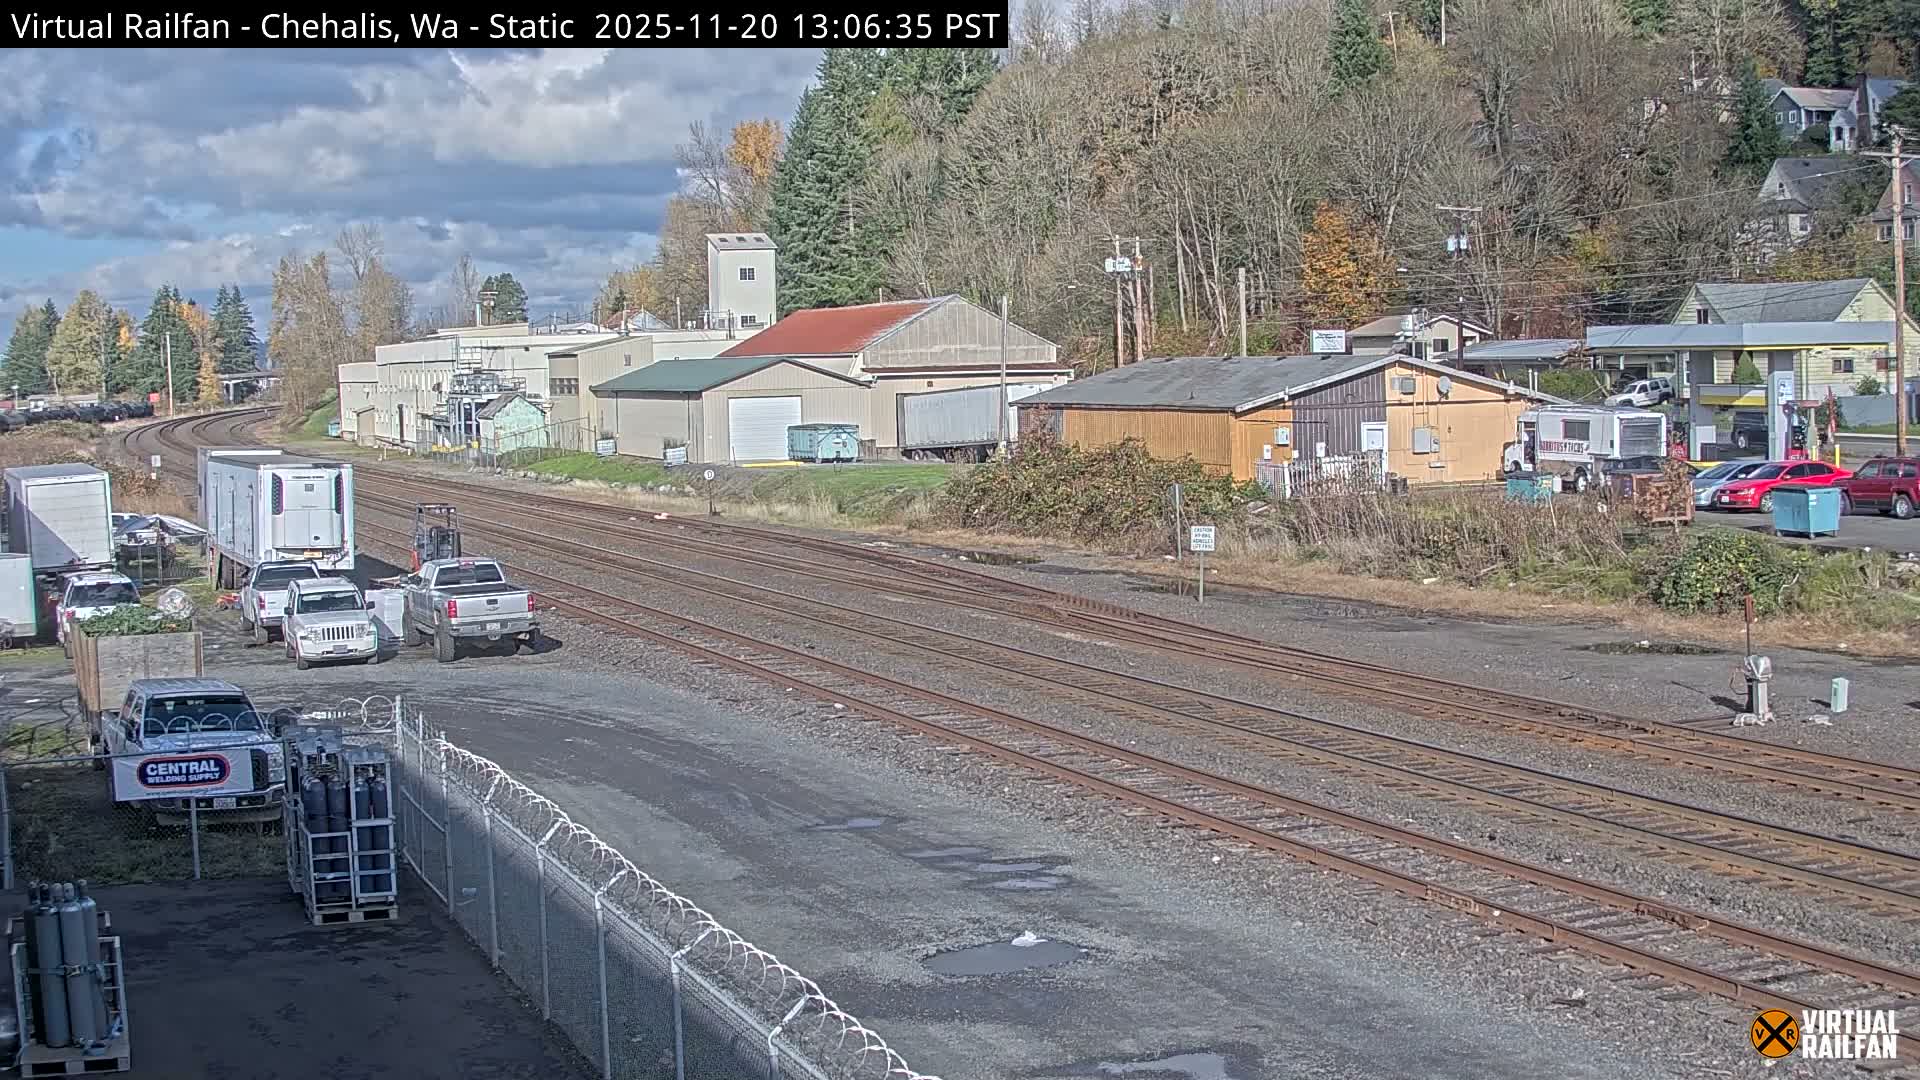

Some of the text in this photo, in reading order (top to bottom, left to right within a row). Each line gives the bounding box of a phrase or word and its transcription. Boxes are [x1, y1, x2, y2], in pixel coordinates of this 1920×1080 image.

[146, 759, 219, 776] CENTRAL
[147, 772, 220, 784] WELDING SUPPLY
